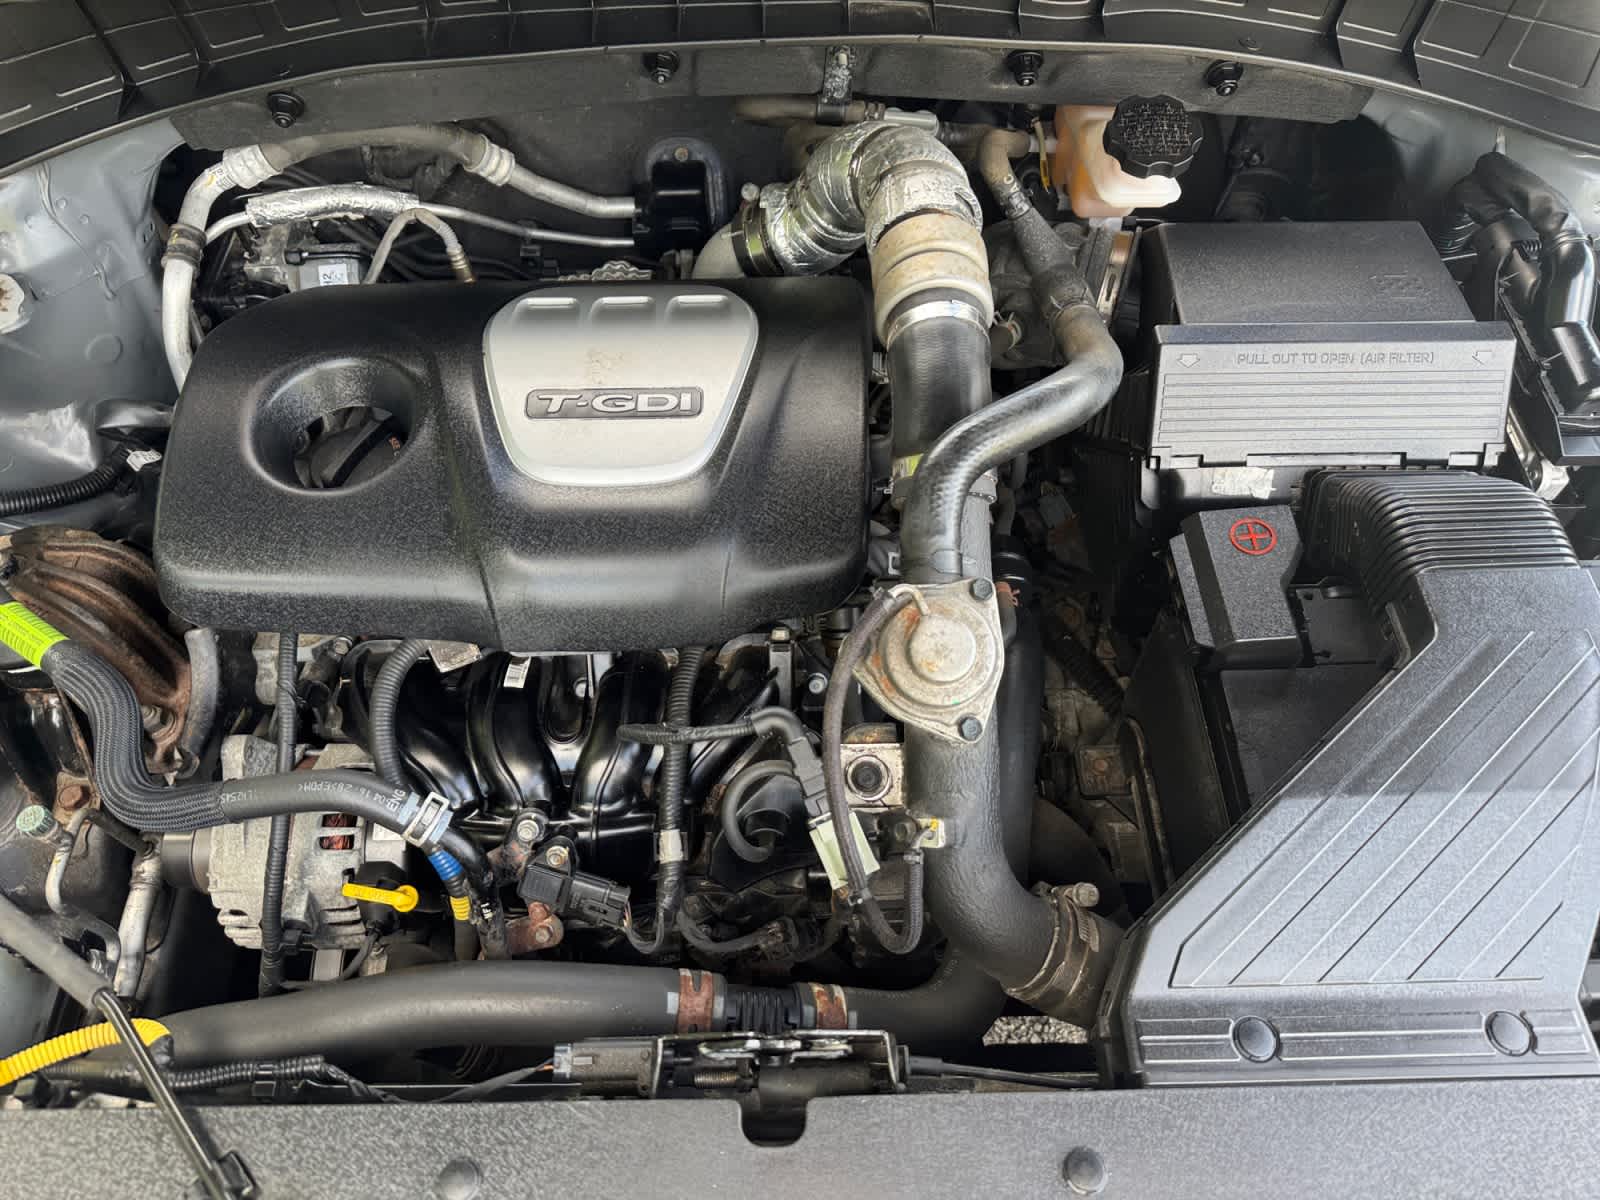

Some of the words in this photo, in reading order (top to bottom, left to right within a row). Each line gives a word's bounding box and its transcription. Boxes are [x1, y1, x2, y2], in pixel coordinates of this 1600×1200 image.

[1237, 352, 1269, 365] PULL
[1272, 352, 1298, 364] OUT
[1301, 352, 1317, 364] TO
[1320, 352, 1354, 365] OPEN
[1360, 351, 1386, 366] (AIR
[1389, 351, 1435, 364] FILTER)
[385, 789, 406, 812] ENG
